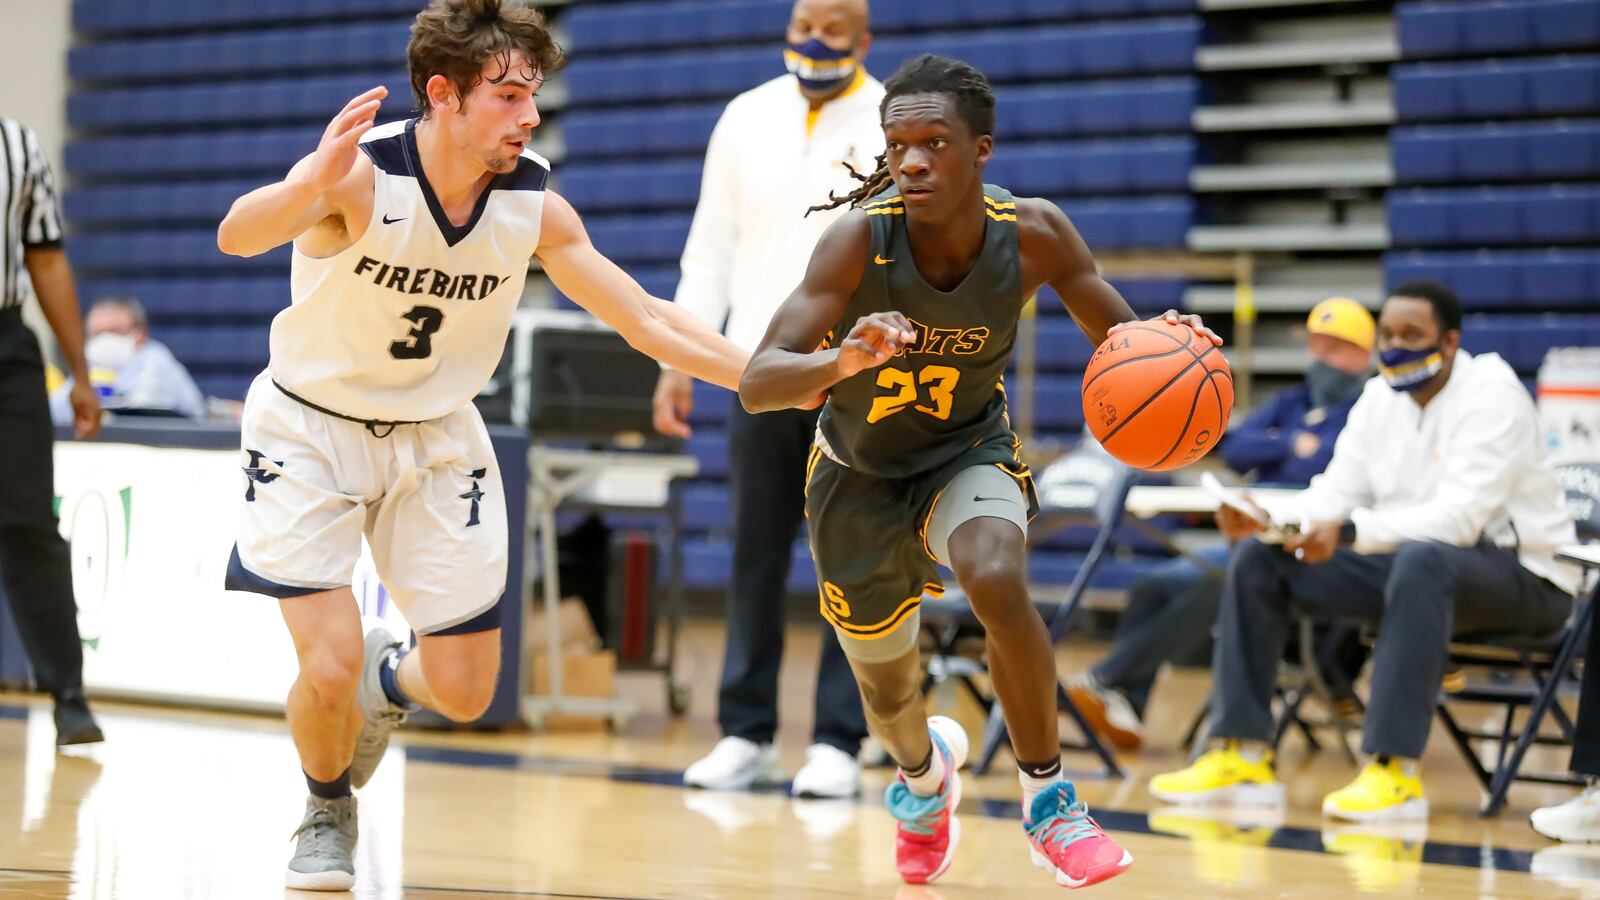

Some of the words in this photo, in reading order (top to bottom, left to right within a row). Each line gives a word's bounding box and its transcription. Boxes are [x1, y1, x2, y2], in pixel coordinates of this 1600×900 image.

[354, 255, 512, 301] FIREBIRD
[388, 304, 445, 360] 3
[866, 364, 961, 424] 23
[823, 580, 851, 618] S
